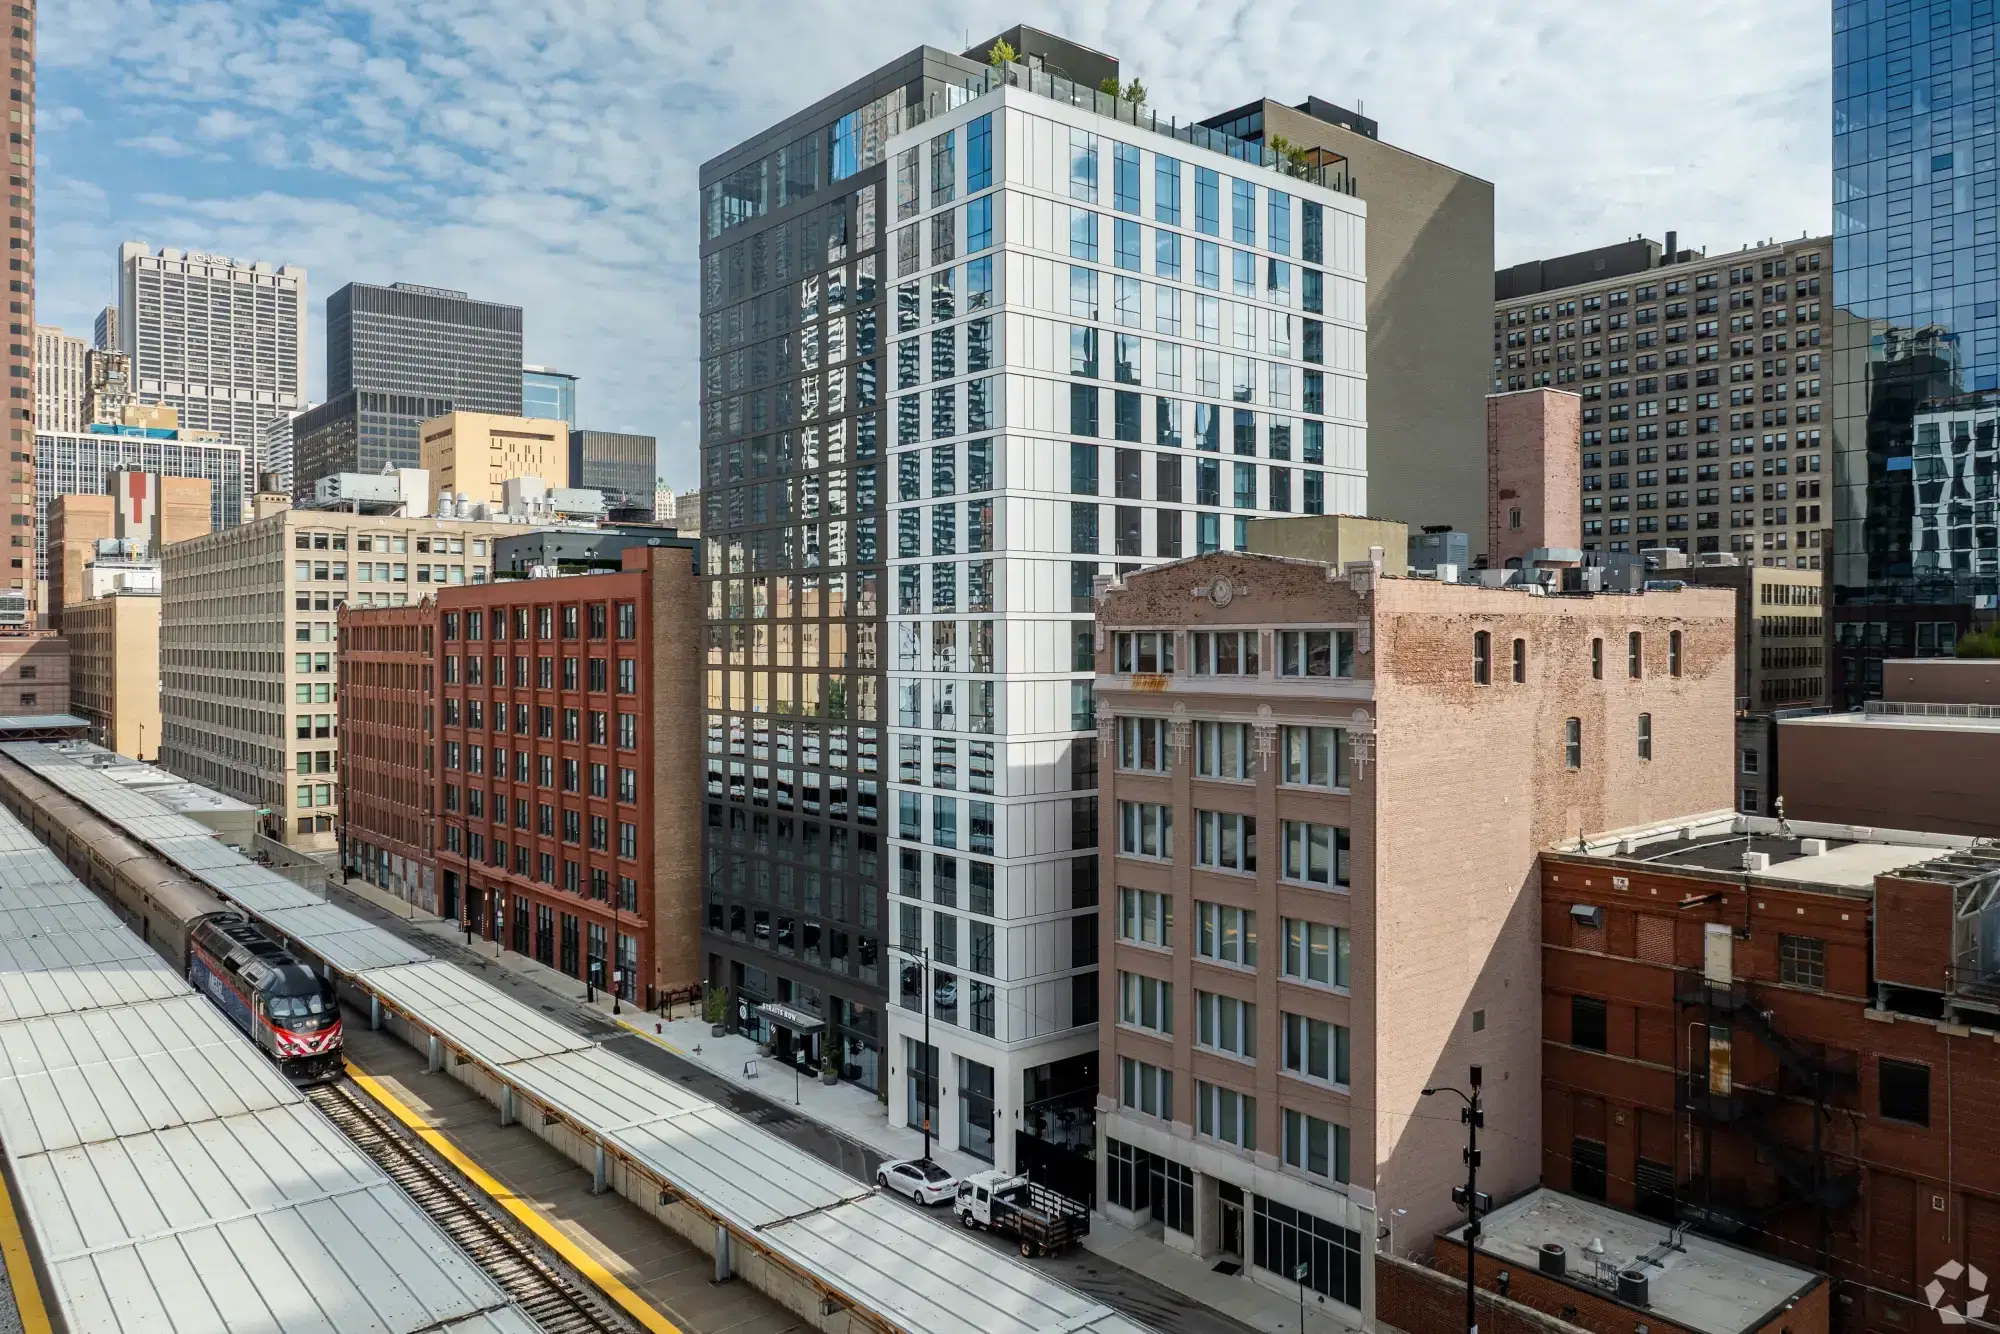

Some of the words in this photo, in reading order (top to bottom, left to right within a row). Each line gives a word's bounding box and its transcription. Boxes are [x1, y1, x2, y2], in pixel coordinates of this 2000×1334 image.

[195, 254, 231, 266] CHASE
[762, 1003, 783, 1016] STRAITS
[784, 1011, 797, 1021] ROW
